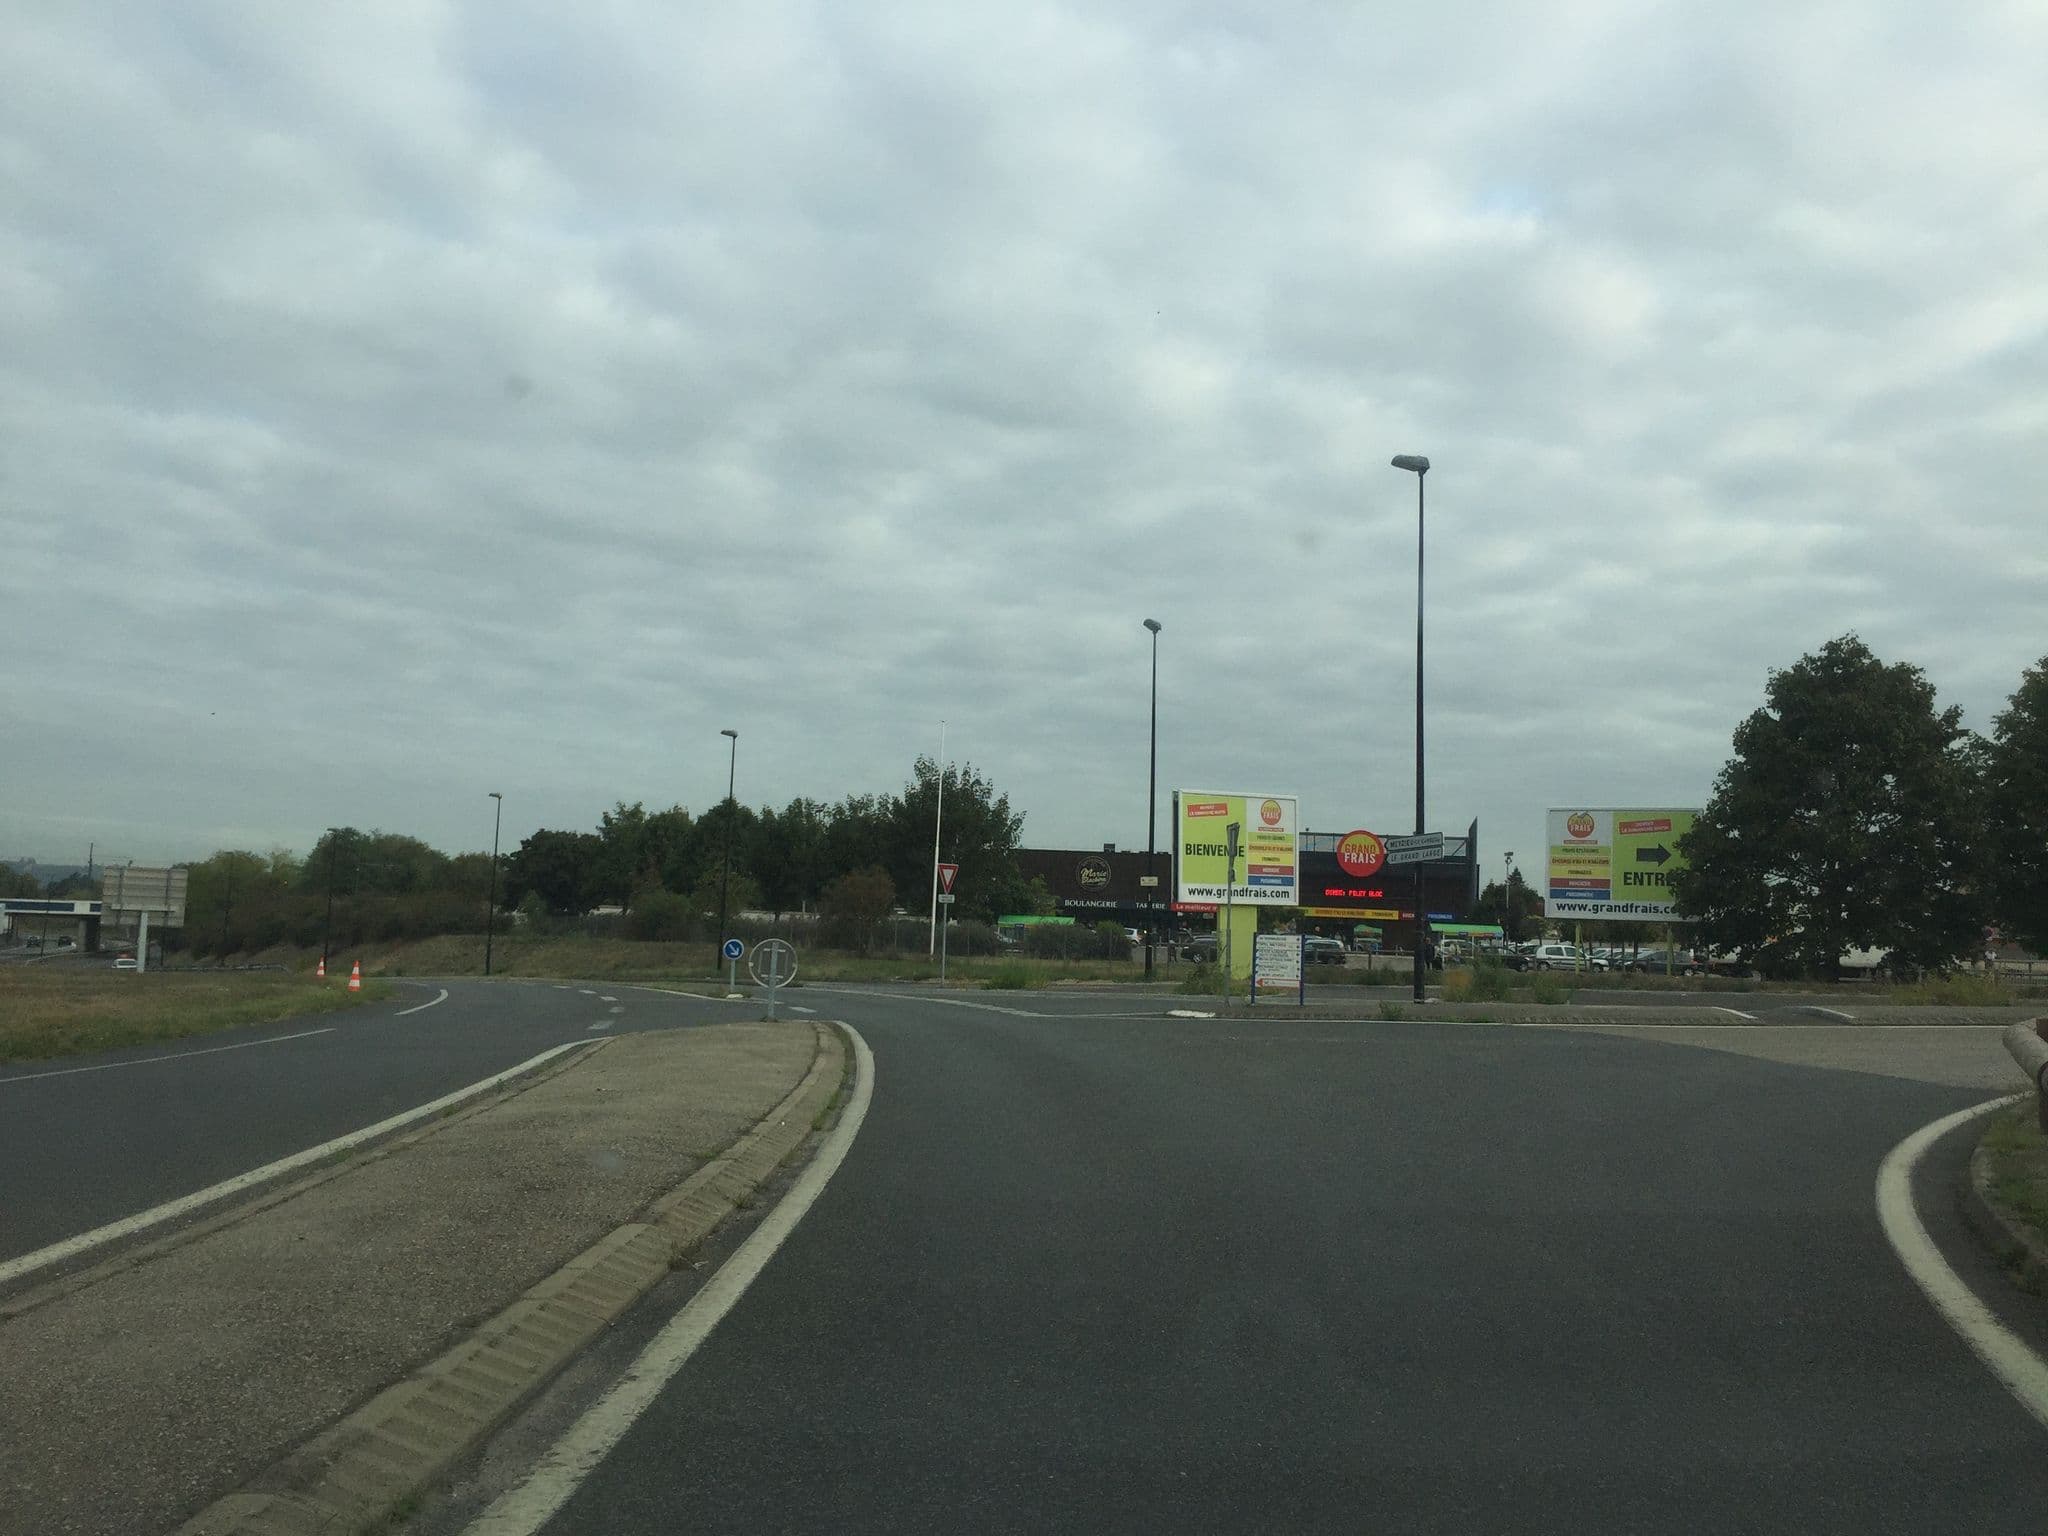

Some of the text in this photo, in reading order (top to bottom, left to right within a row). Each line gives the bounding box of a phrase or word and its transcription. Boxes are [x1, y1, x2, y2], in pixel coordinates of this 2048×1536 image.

[1263, 811, 1280, 819] FRAIS
[1570, 824, 1592, 832] FRAIS
[1344, 843, 1377, 855] GRAND
[1344, 853, 1377, 864] FRAIS
[1623, 871, 1673, 887] ENTR
[1064, 899, 1118, 909] BOULANGERIE
[1556, 903, 1679, 915] www.grandfrais.co
